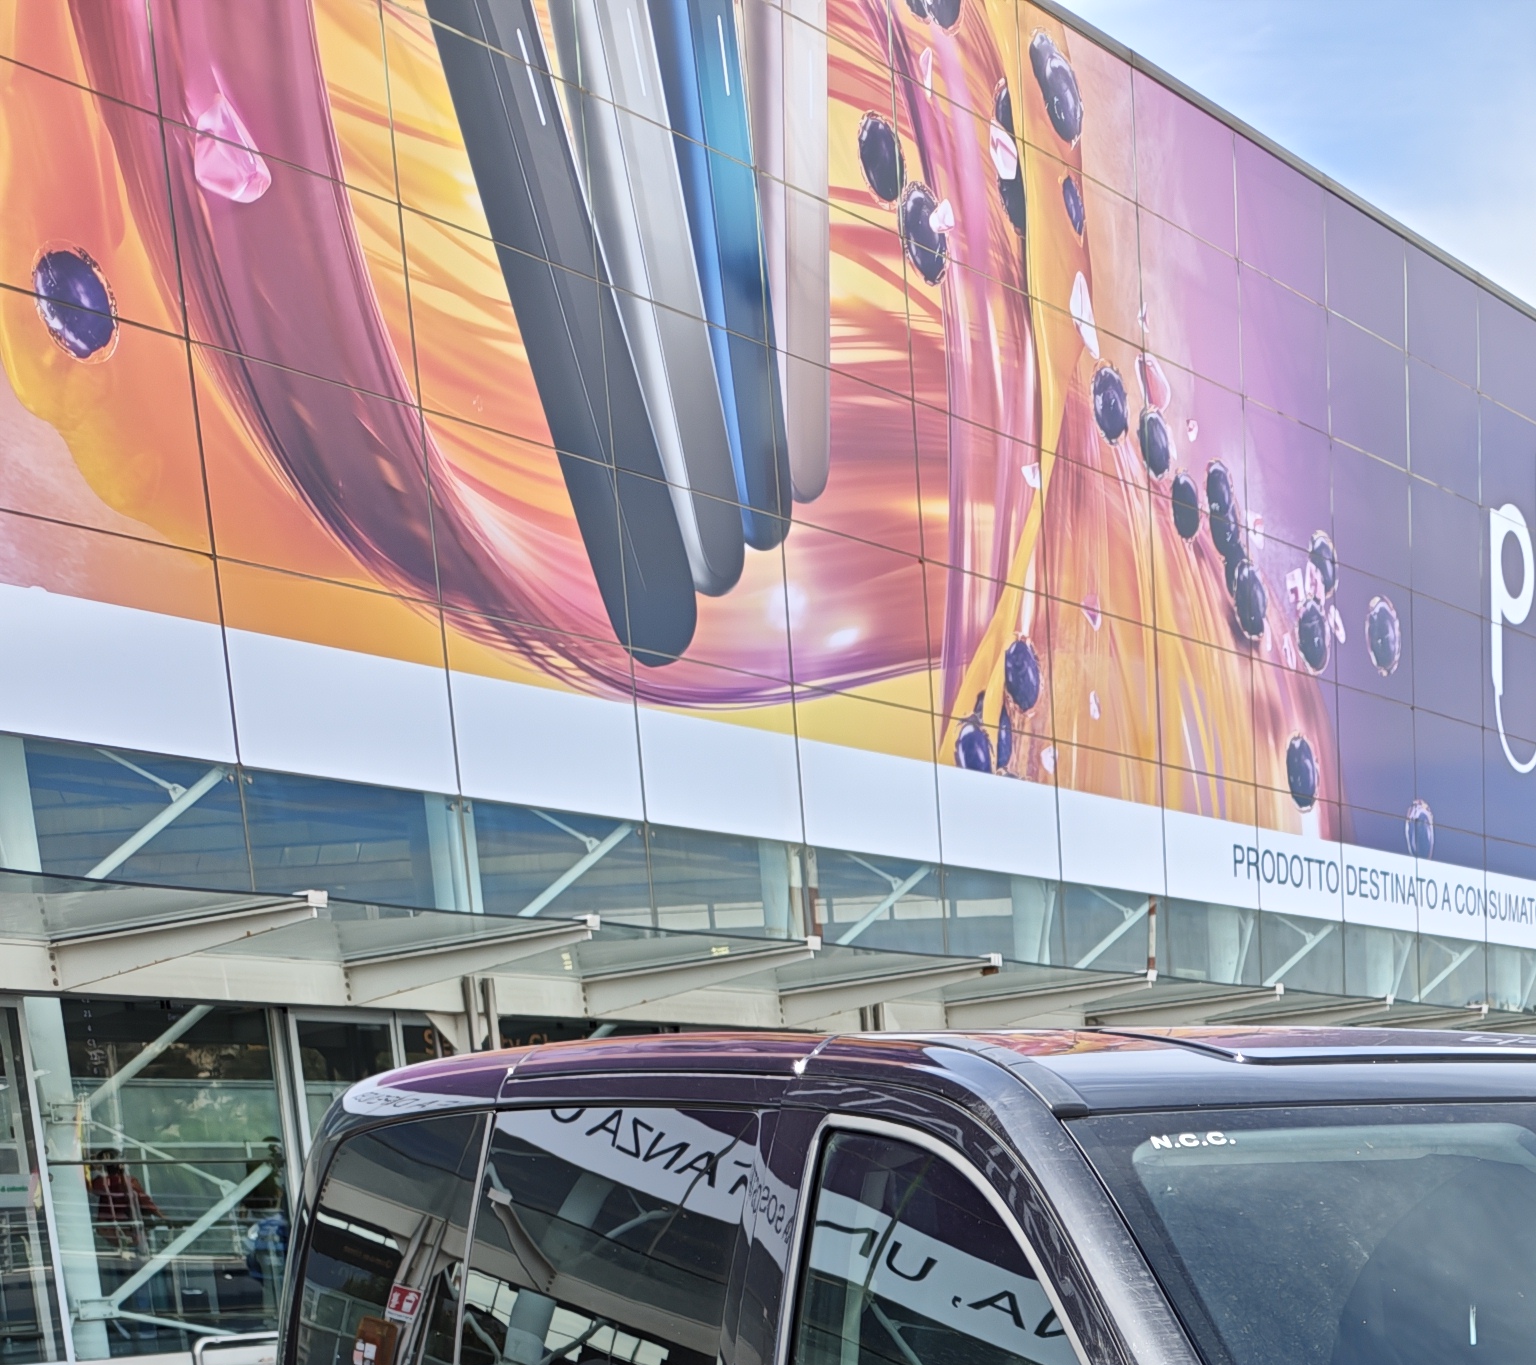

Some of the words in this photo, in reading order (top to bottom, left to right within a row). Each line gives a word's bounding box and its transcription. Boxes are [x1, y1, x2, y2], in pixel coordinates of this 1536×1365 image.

[1233, 843, 1339, 894] PRODOTTO
[1346, 864, 1437, 910] DESTINATO
[1441, 882, 1452, 912] A
[1150, 1131, 1236, 1150] N.C.C.
